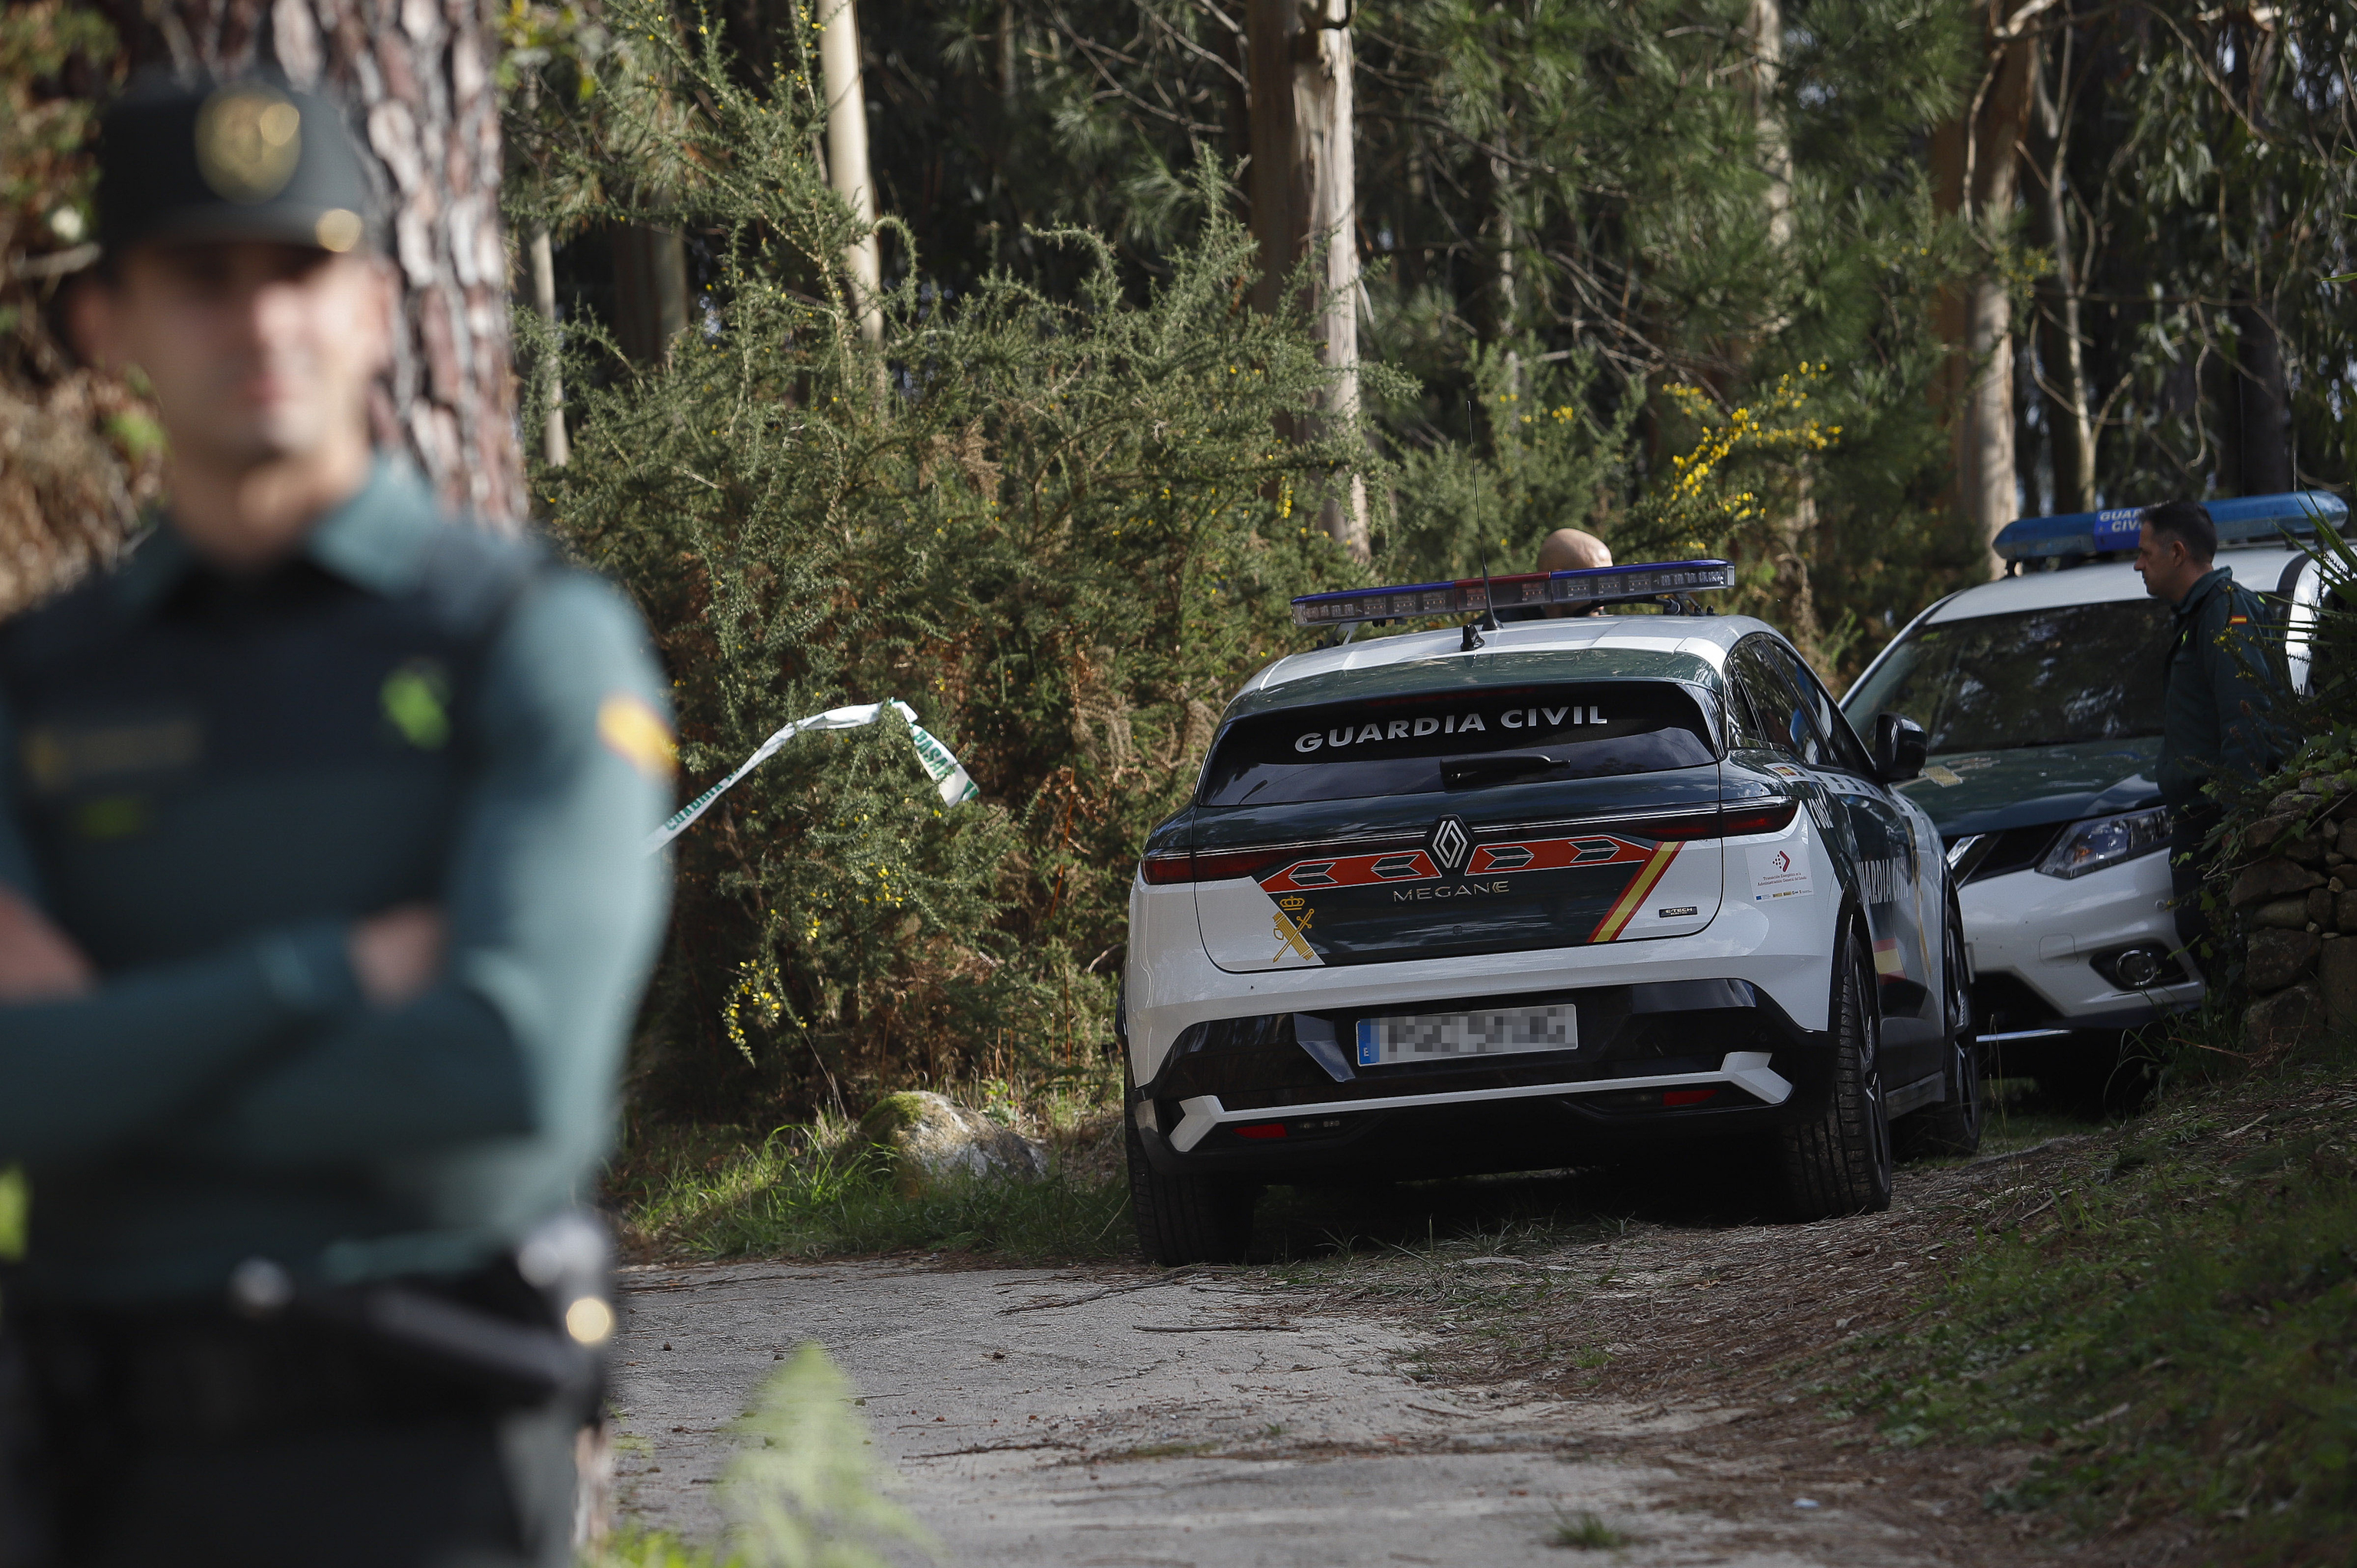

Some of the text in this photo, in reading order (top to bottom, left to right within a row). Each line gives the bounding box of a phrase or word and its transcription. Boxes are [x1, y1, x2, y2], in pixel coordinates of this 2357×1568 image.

[1294, 706, 1608, 753] GUARDIA CIVIL
[1393, 881, 1510, 902] MEGANE
[1363, 1047, 1370, 1057] E
